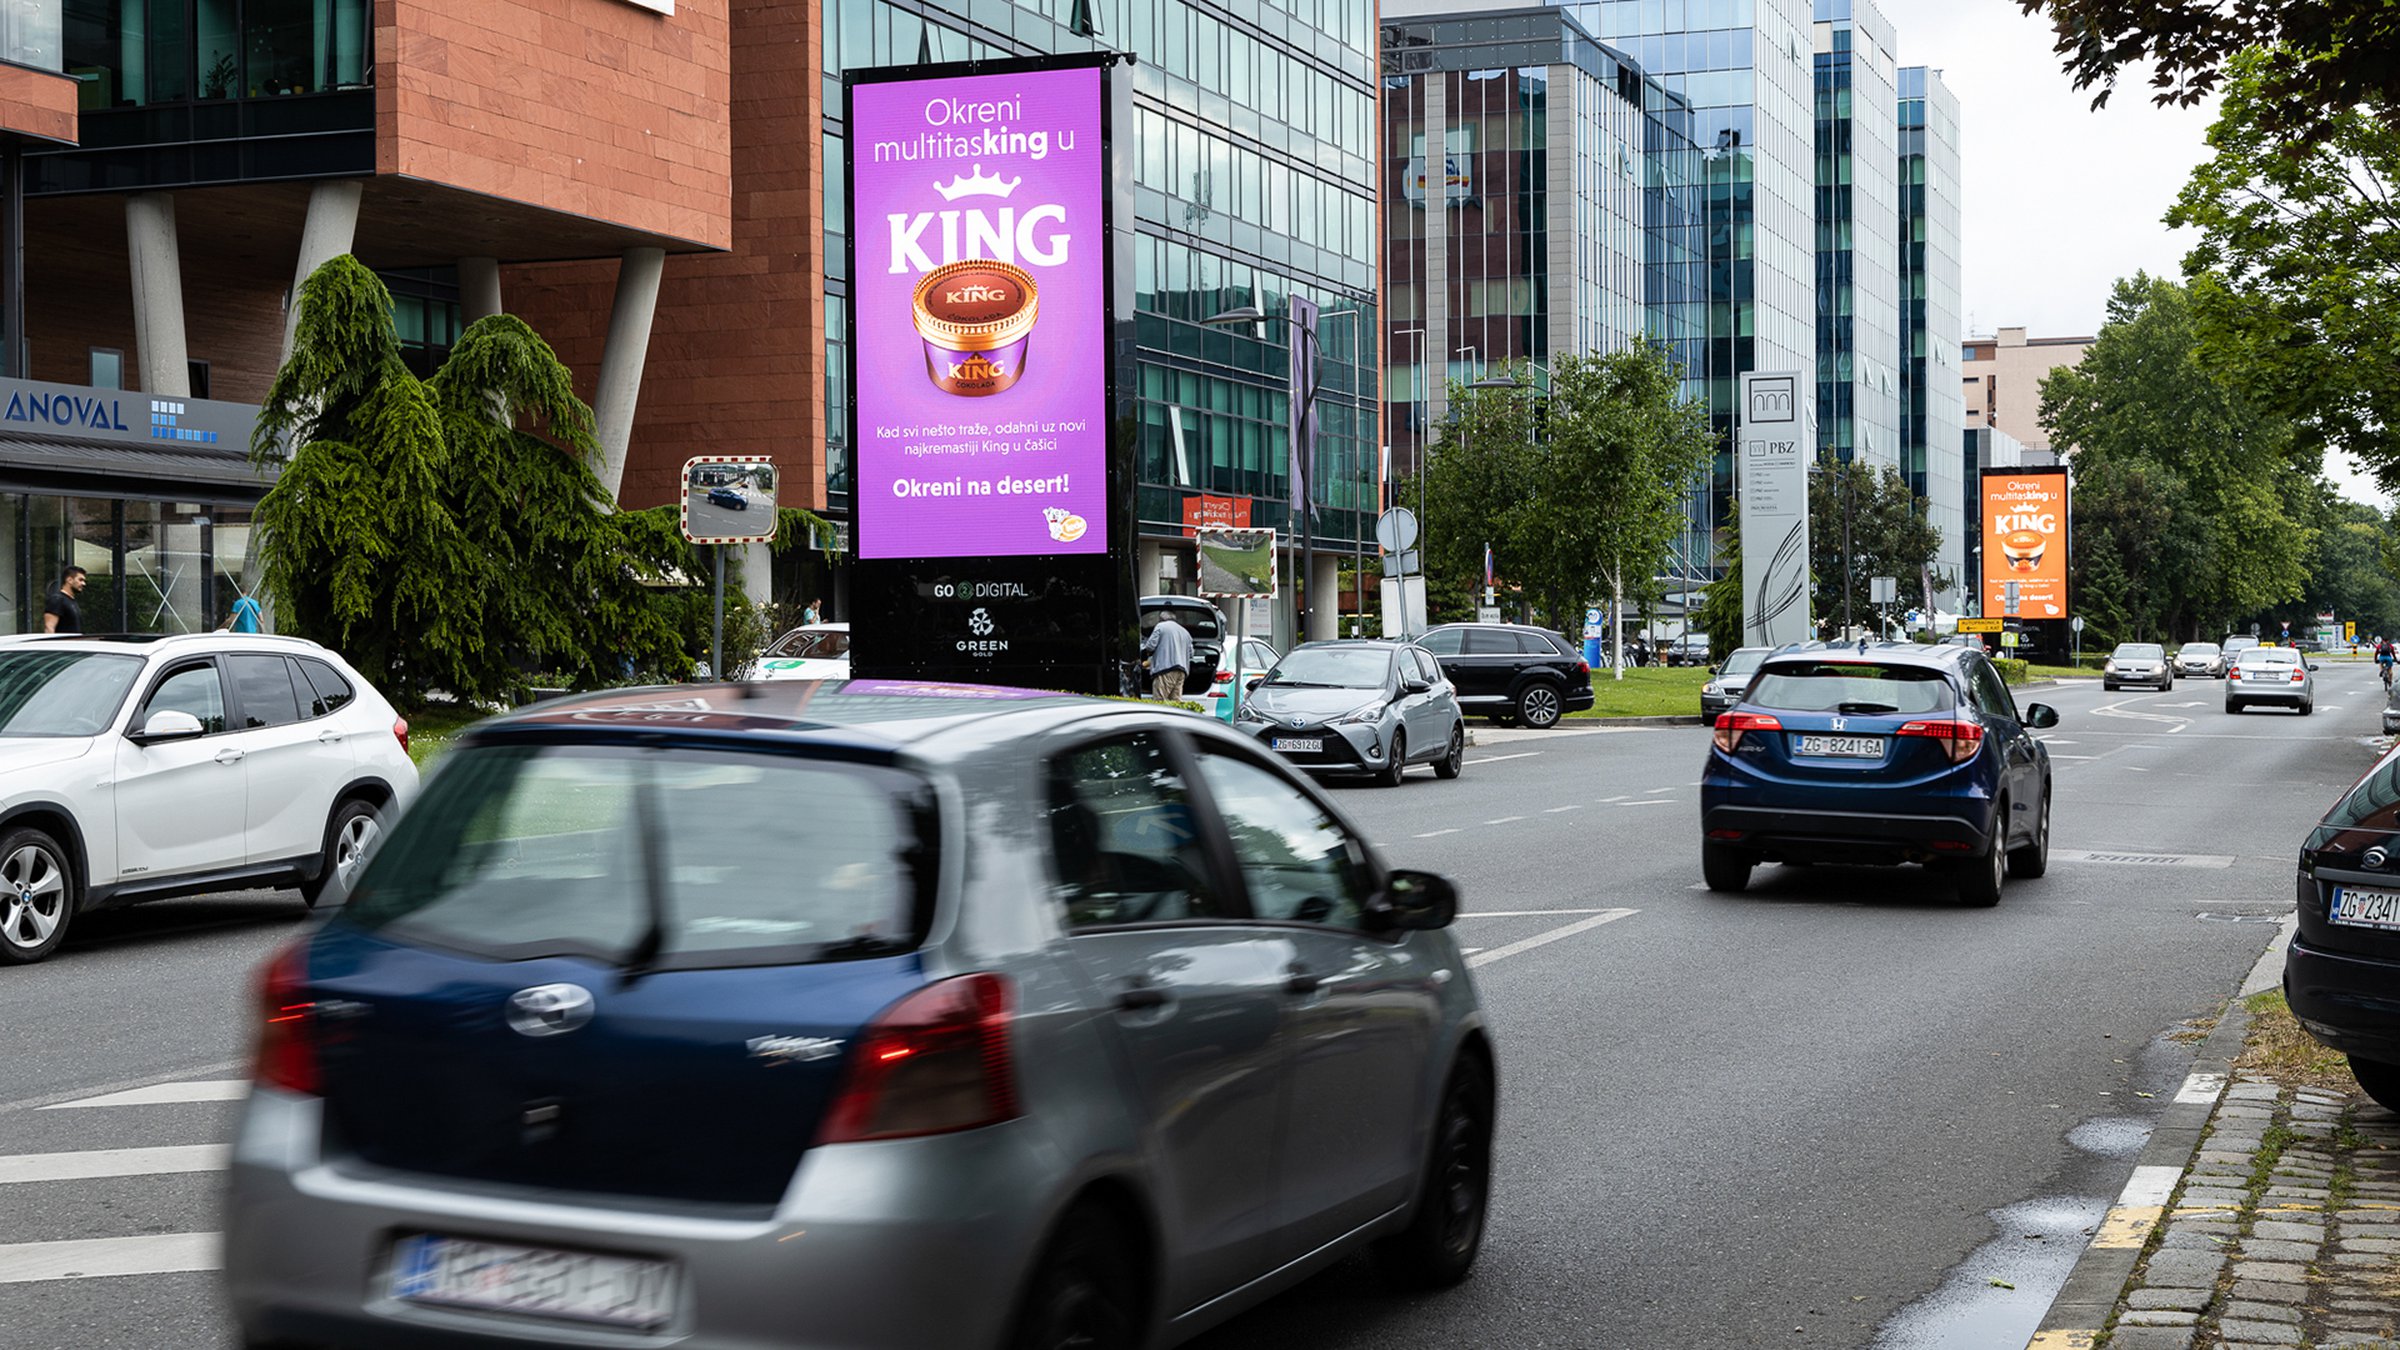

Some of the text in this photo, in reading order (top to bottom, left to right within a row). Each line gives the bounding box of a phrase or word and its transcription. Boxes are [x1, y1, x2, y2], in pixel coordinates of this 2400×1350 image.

[925, 93, 1020, 126] Okreni
[874, 125, 1075, 162] multitasking u
[887, 204, 1071, 274] KING
[945, 289, 1006, 304] KING
[948, 360, 1005, 380] KING
[4, 389, 129, 431] ANOVAL
[876, 419, 1086, 439] Kad svi nešto traže, odahni uz novi
[905, 438, 1057, 458] najkremastiji King u čašici
[1770, 441, 1795, 454] PBZ
[892, 473, 1070, 498] Okreni na desert!
[2007, 481, 2040, 491] Okreni
[1990, 490, 2058, 502] multitasking u
[1995, 513, 2056, 534] KING
[934, 584, 954, 597] GO
[976, 582, 1029, 597] DIGITAL
[956, 640, 1008, 651] GREEN
[1277, 739, 1287, 750] ZG
[1804, 737, 1882, 754] ZG 8241-GA
[2340, 891, 2399, 922] ZG 2341
